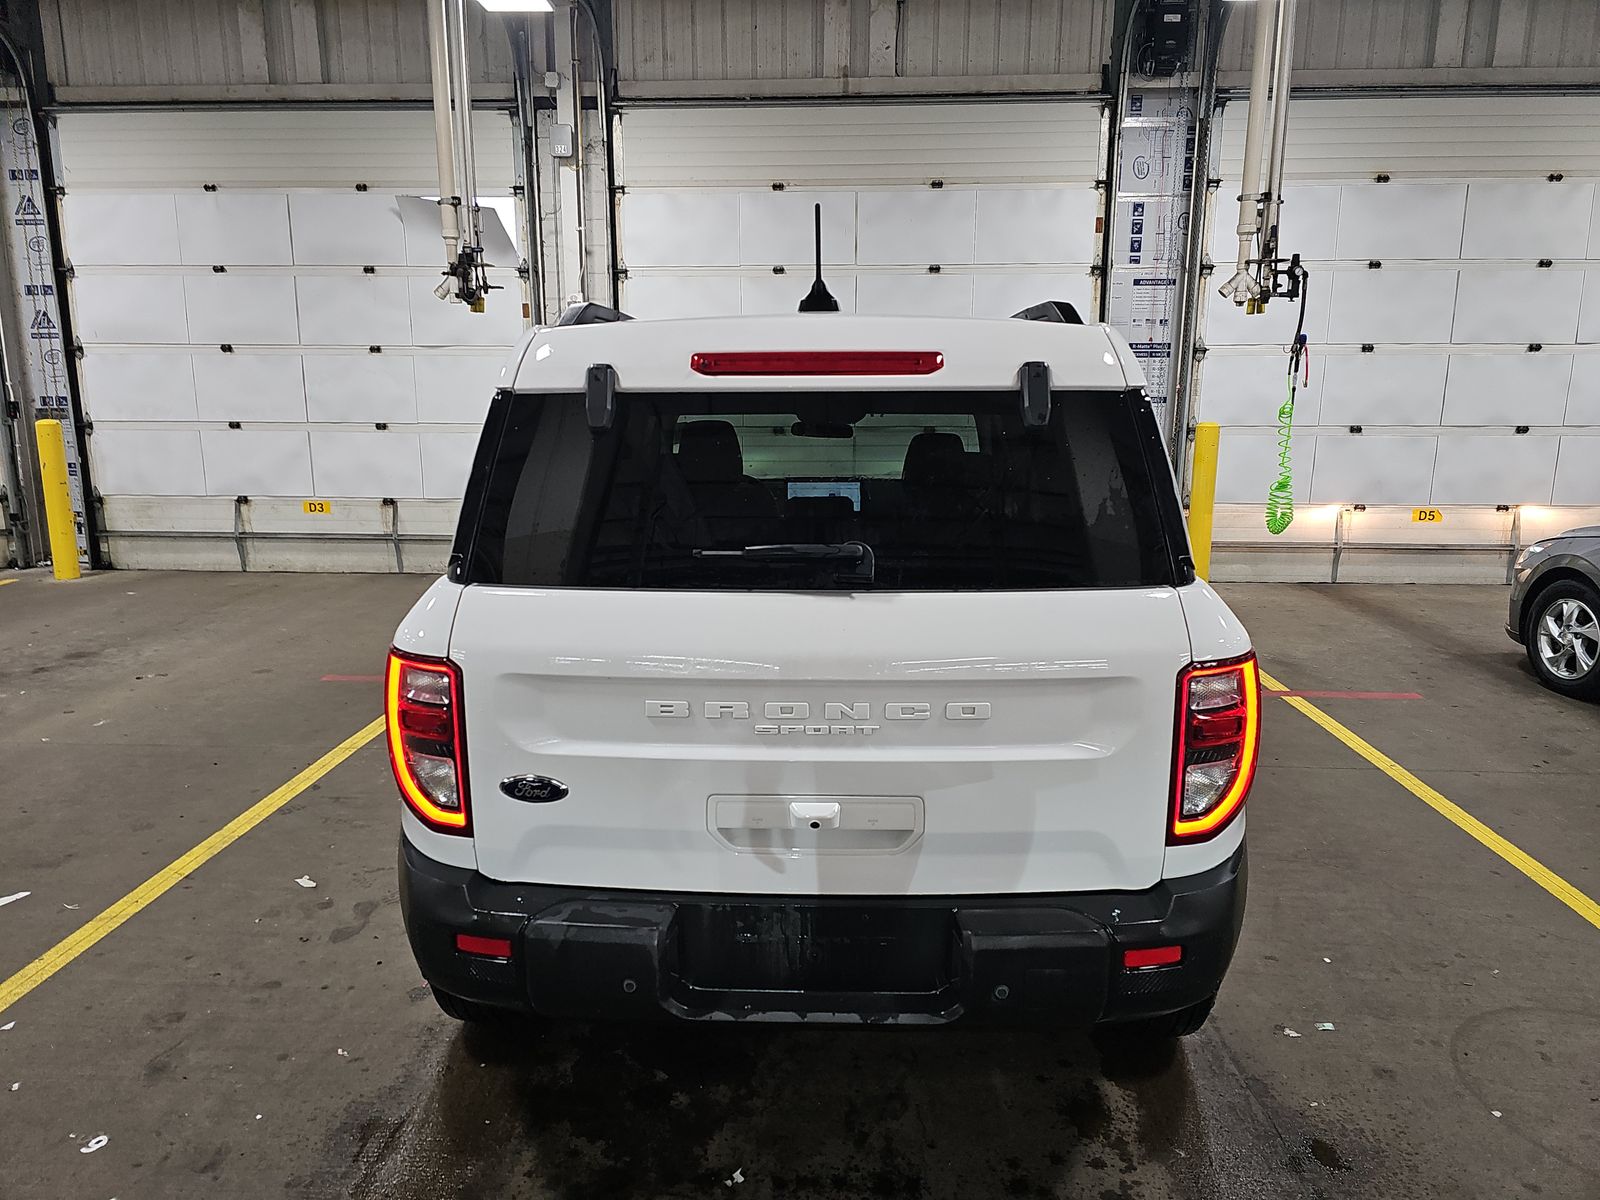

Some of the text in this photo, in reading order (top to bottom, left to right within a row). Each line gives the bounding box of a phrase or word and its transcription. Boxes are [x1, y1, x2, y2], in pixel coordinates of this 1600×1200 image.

[308, 502, 325, 513] D3
[1418, 510, 1436, 521] D5
[645, 700, 992, 720] BRONCO
[754, 725, 880, 736] SPORT
[514, 781, 551, 798] Ford
